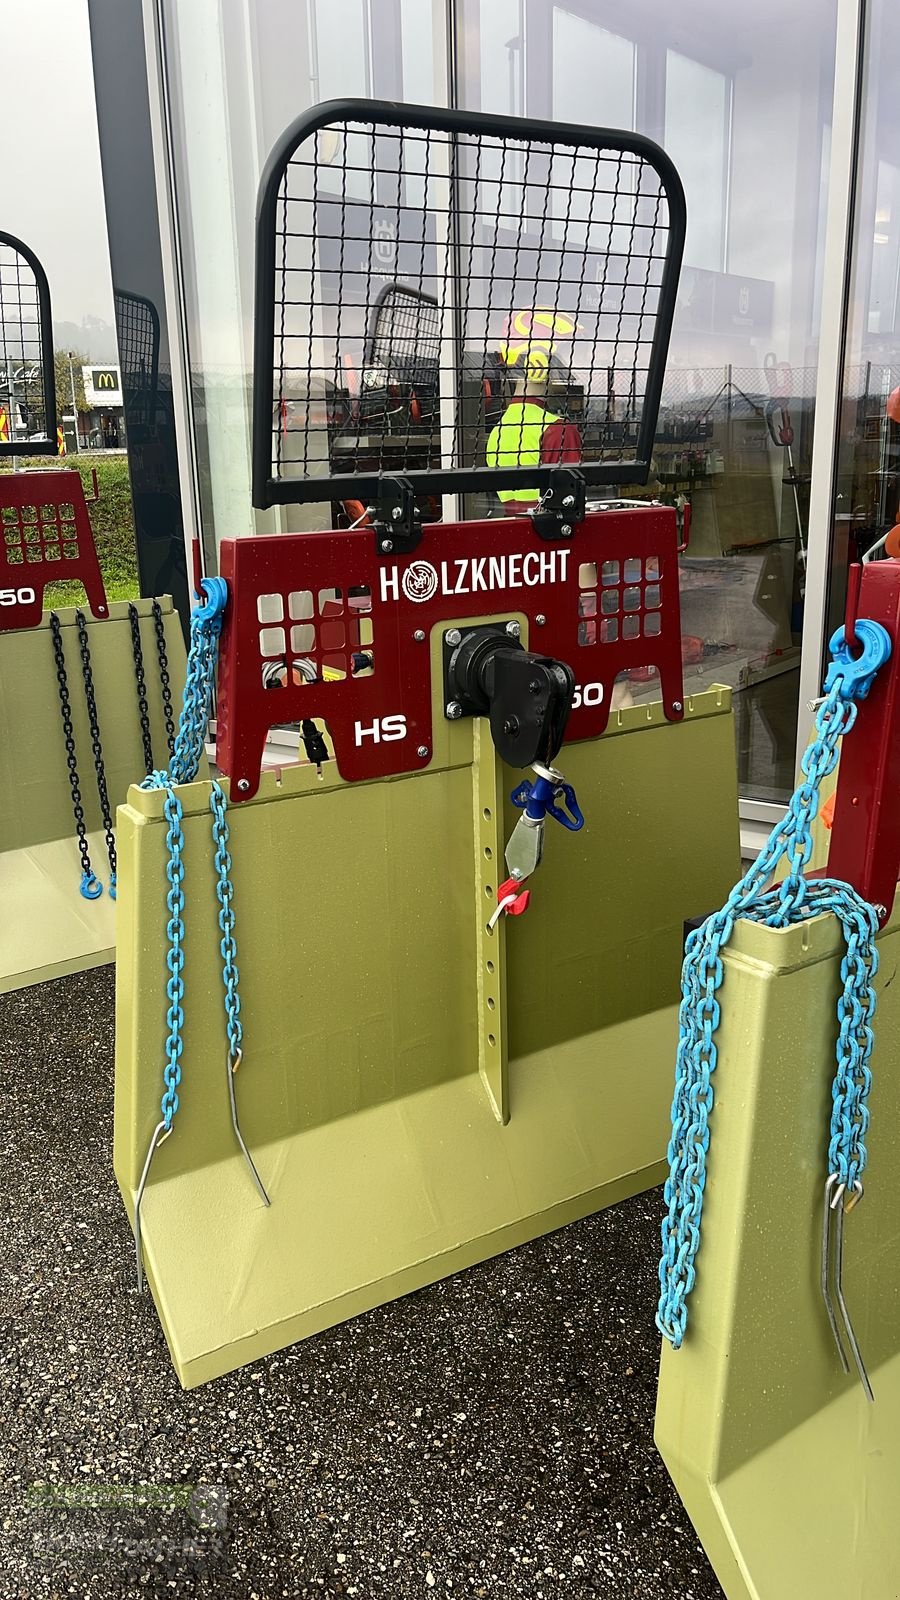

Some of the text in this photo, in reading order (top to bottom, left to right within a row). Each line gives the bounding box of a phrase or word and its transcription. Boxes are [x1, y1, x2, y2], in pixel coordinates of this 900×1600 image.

[379, 549, 571, 603] HOLZKNECHT
[0, 587, 36, 606] 50
[354, 714, 407, 747] HS
